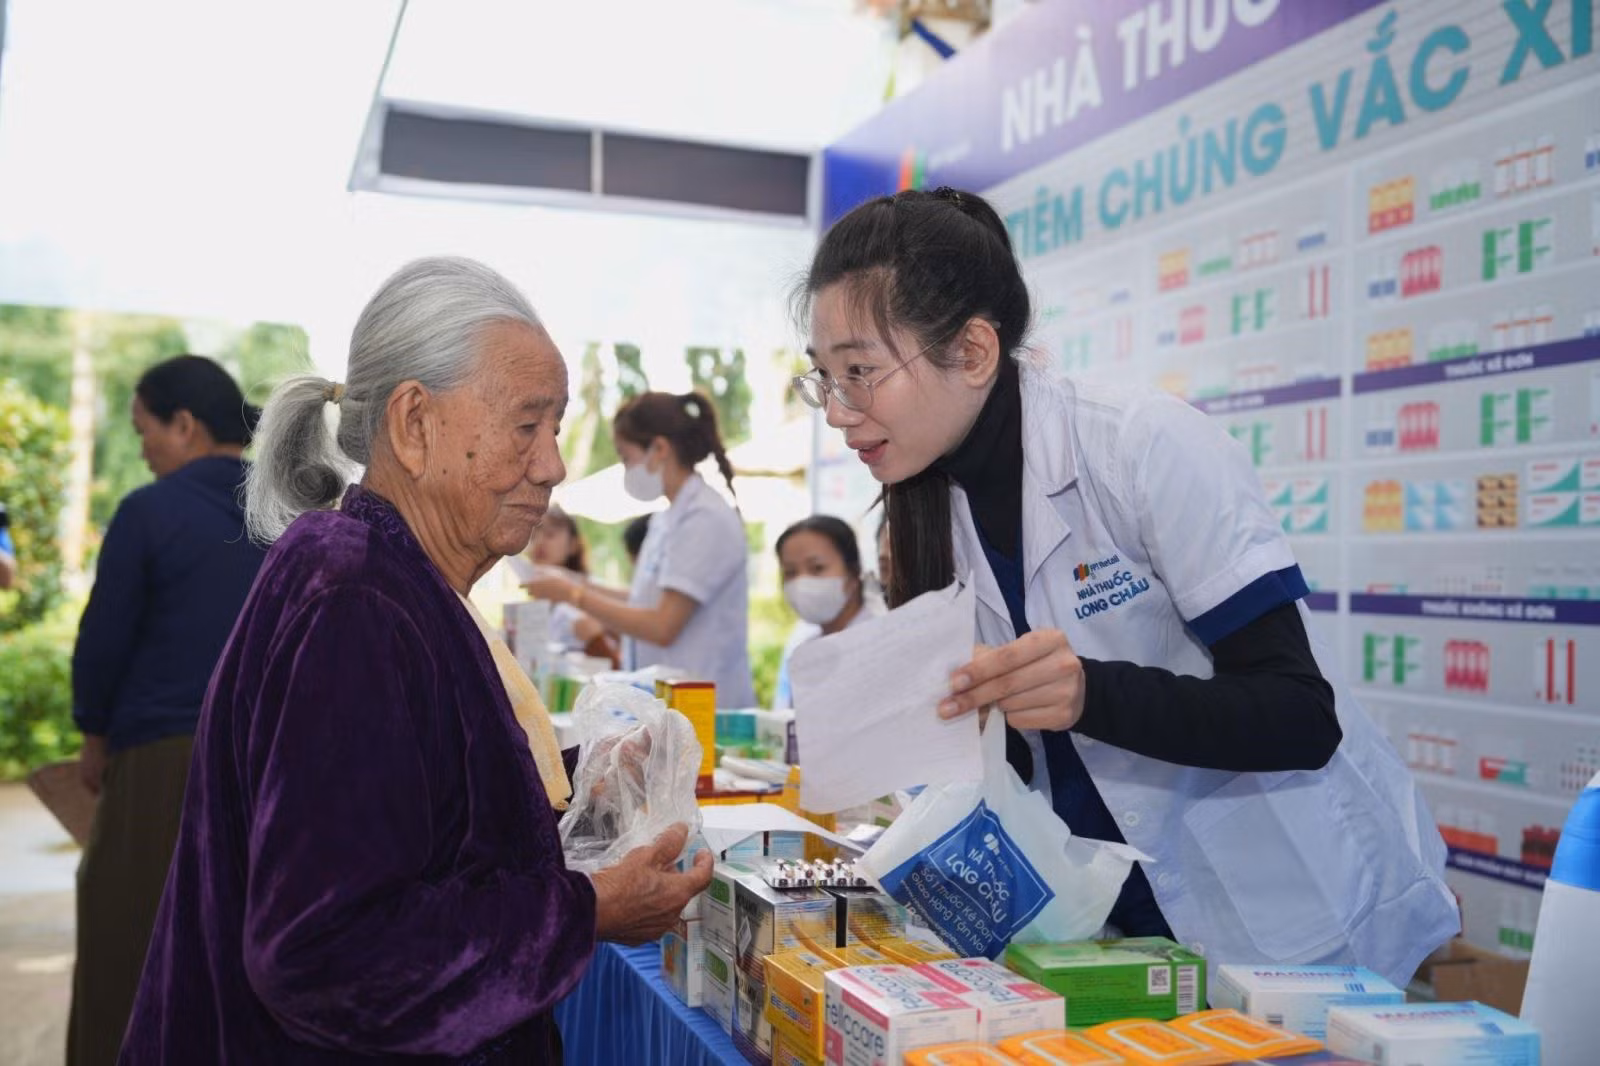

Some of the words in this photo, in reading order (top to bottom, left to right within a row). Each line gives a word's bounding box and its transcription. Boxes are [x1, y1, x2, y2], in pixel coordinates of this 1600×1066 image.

[1001, 36, 1102, 152] NHÀ
[1100, 103, 1287, 229] CHỦNG
[1309, 9, 1471, 151] VẮC
[1074, 598, 1108, 620] LONG
[1109, 577, 1150, 606] CHÂU
[1077, 583, 1097, 600] NHÀ
[1094, 570, 1133, 593] THUỐC
[912, 872, 930, 898] Giao
[983, 860, 1010, 900] THỐC
